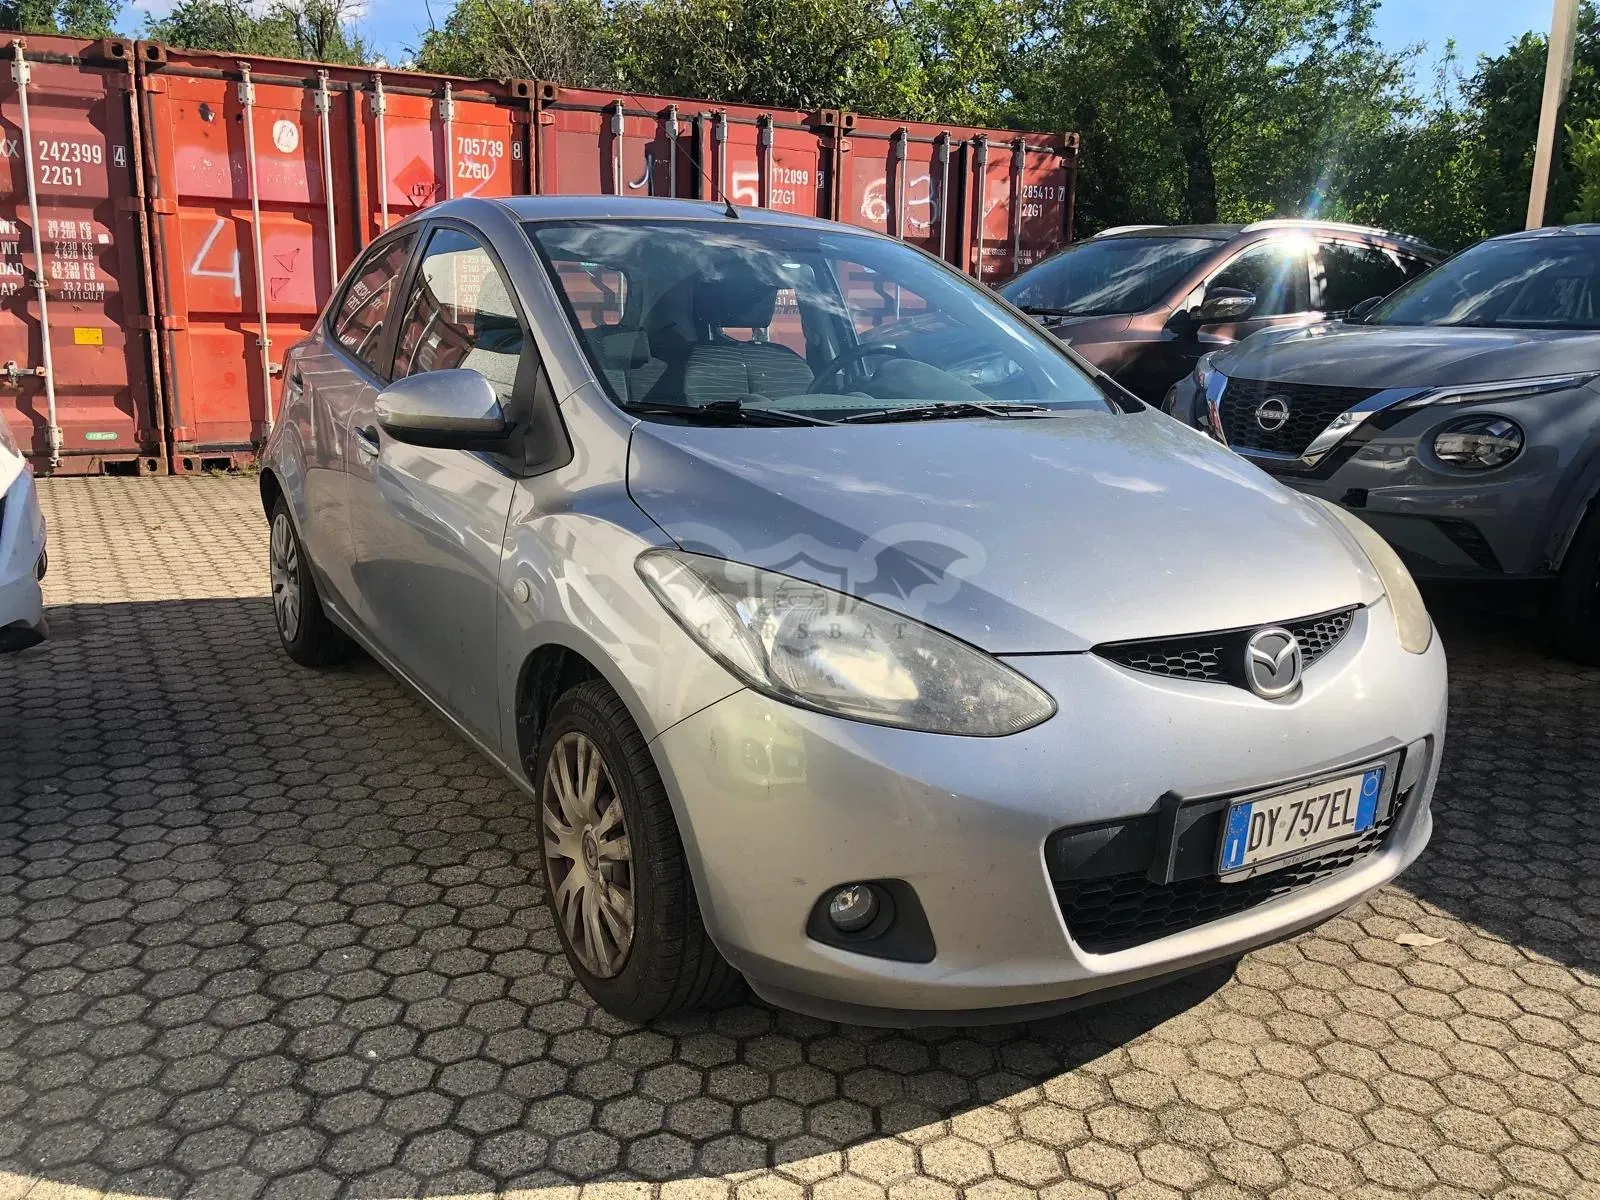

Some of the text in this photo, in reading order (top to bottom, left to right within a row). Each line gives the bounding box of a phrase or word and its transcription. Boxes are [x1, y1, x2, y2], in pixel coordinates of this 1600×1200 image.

[39, 140, 102, 164] 242399
[114, 146, 125, 166] 4
[457, 137, 521, 159] 705739 8
[41, 165, 82, 186] 22G1
[772, 189, 796, 205] 22G1
[1023, 185, 1054, 200] 285413
[1022, 204, 1043, 217] 22G1
[79, 222, 92, 230] KG
[80, 230, 92, 240] LB
[82, 242, 93, 251] KG
[82, 251, 94, 260] LB
[192, 219, 241, 297] 4
[83, 262, 95, 271] KG
[84, 270, 96, 280] LB
[1254, 409, 1289, 420] NISSAN
[1248, 806, 1282, 851] DY
[1284, 788, 1355, 842] 757EL
